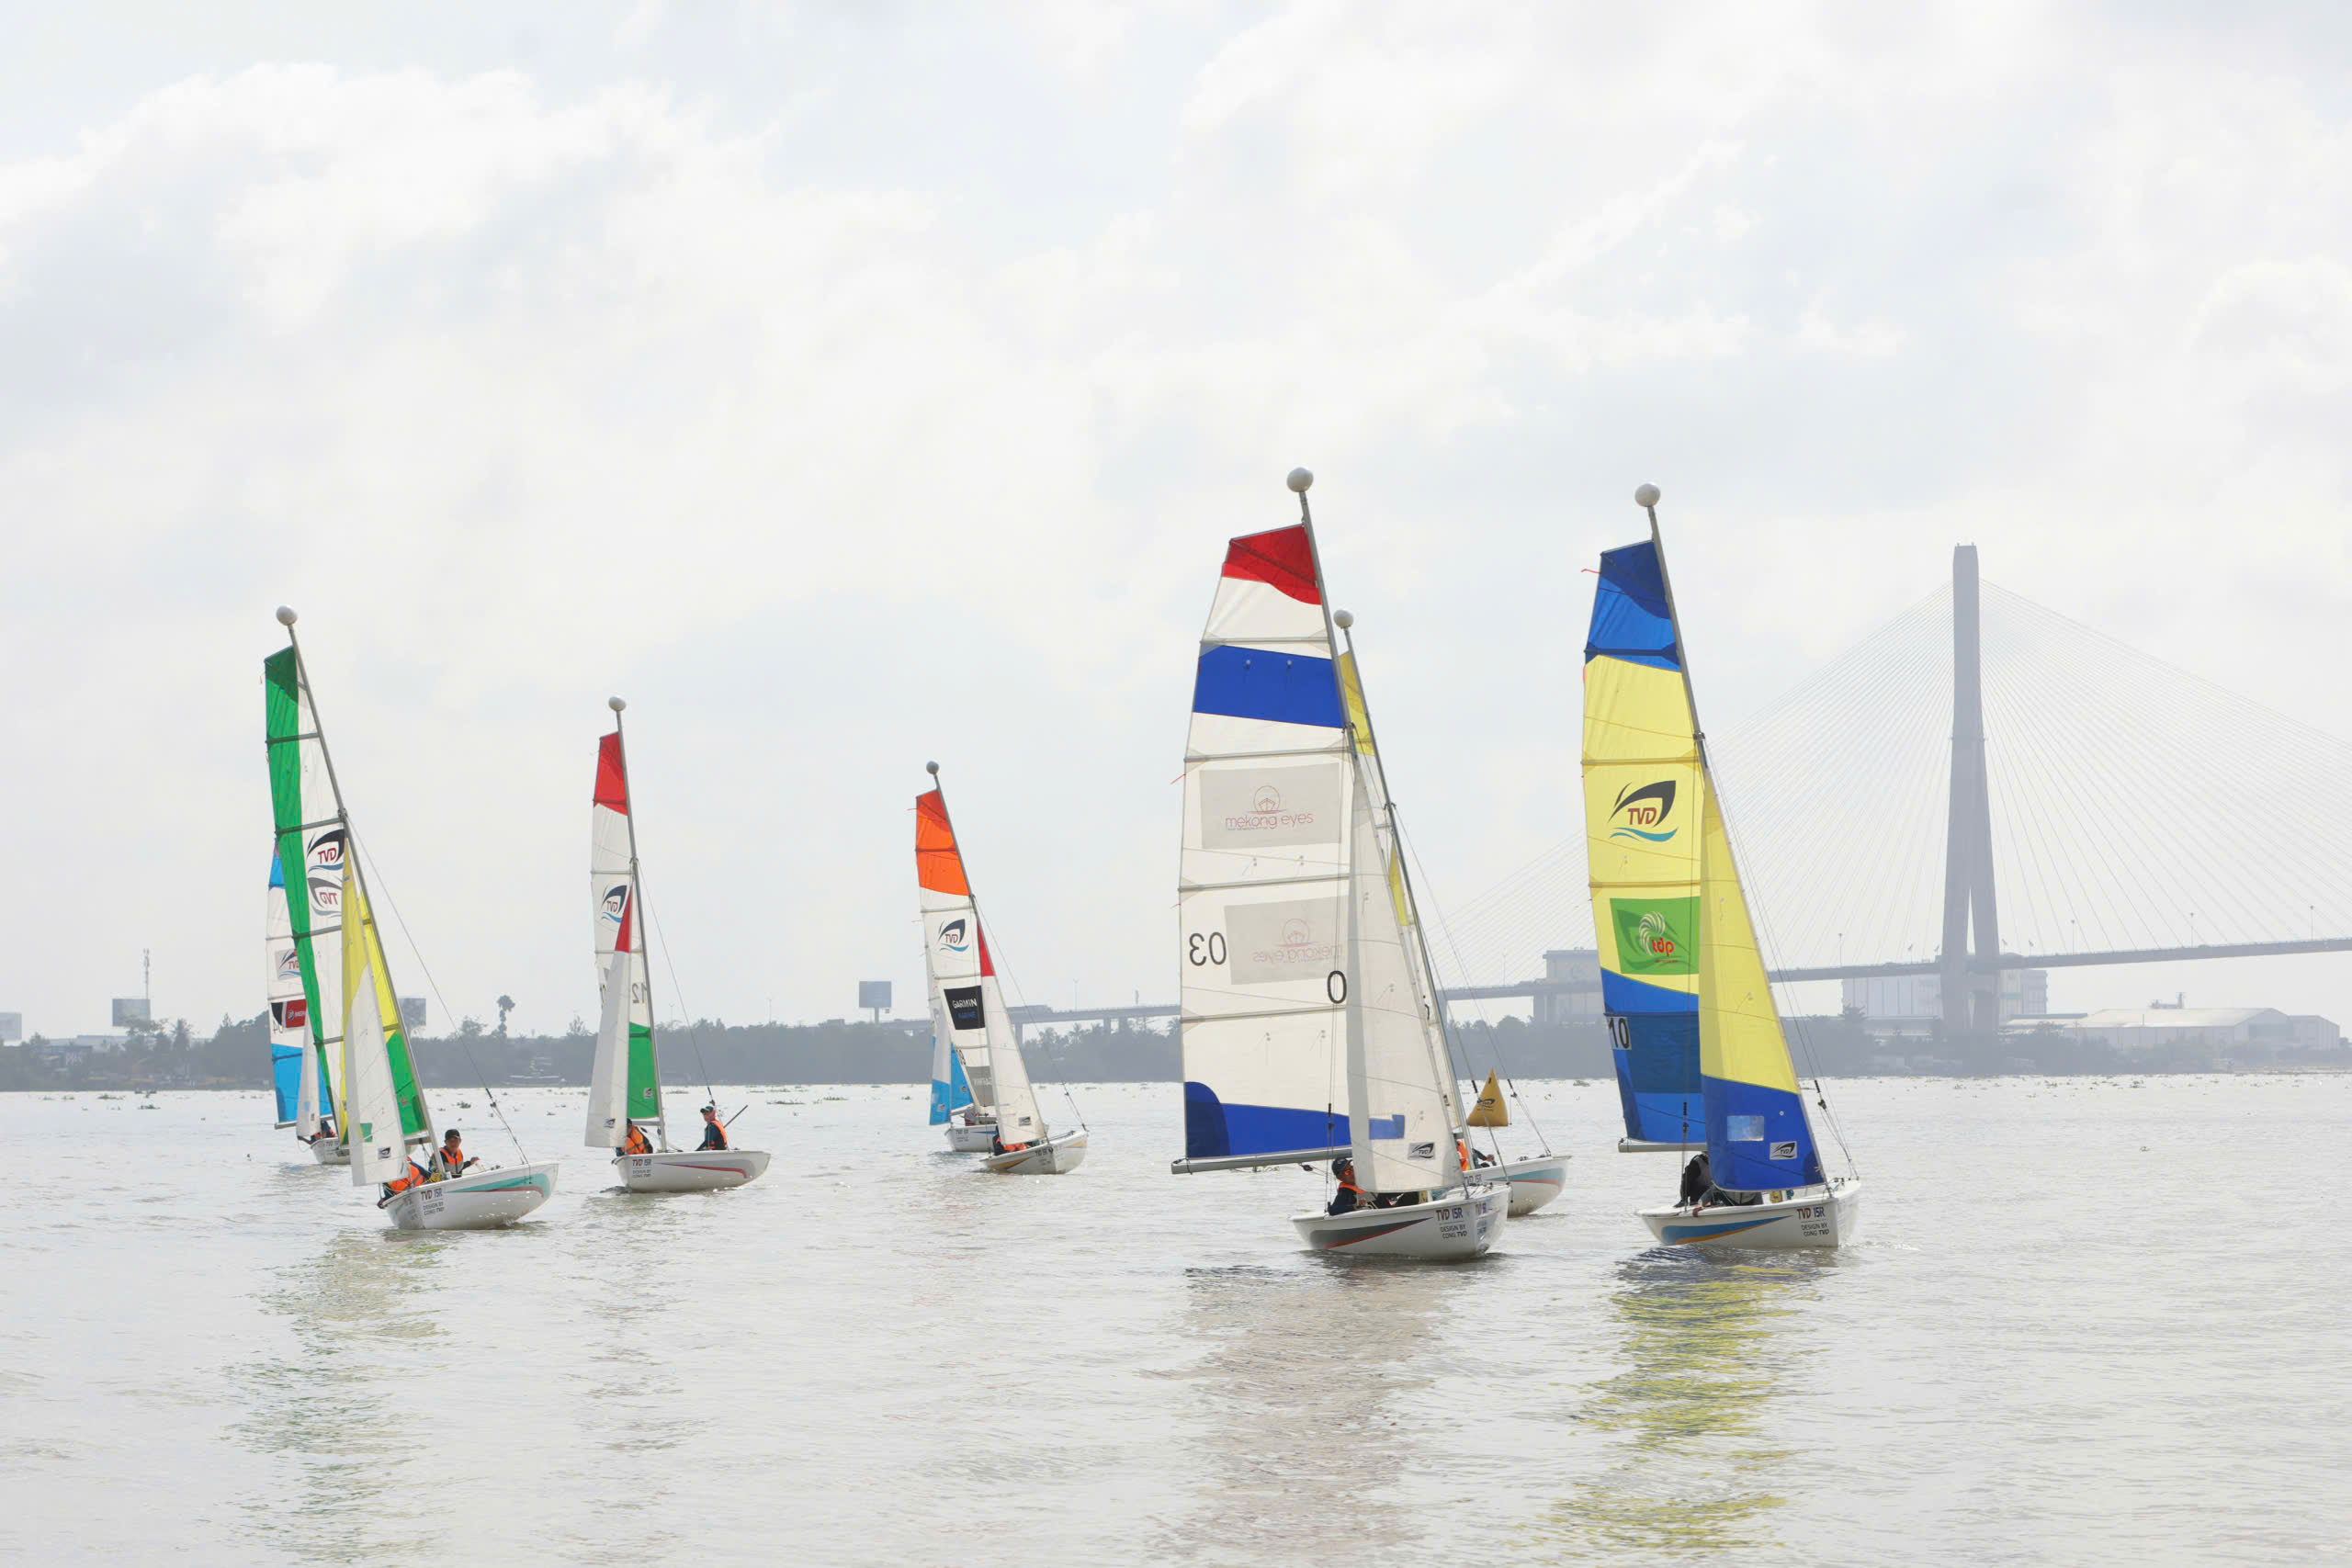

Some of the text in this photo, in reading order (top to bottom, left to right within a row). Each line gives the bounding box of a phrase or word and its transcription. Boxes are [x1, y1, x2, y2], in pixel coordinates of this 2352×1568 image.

[1226, 813, 1314, 829] mekong eyes
[1627, 807, 1657, 825] TVD
[317, 847, 337, 863] TVD
[606, 900, 618, 912] TVD
[944, 934, 958, 944] TVD
[1651, 937, 1675, 957] tdp
[952, 998, 978, 1009] GARMIN
[1609, 1017, 1630, 1049] 10
[1435, 1208, 1450, 1221] TVD
[1797, 1207, 1811, 1220] TVD
